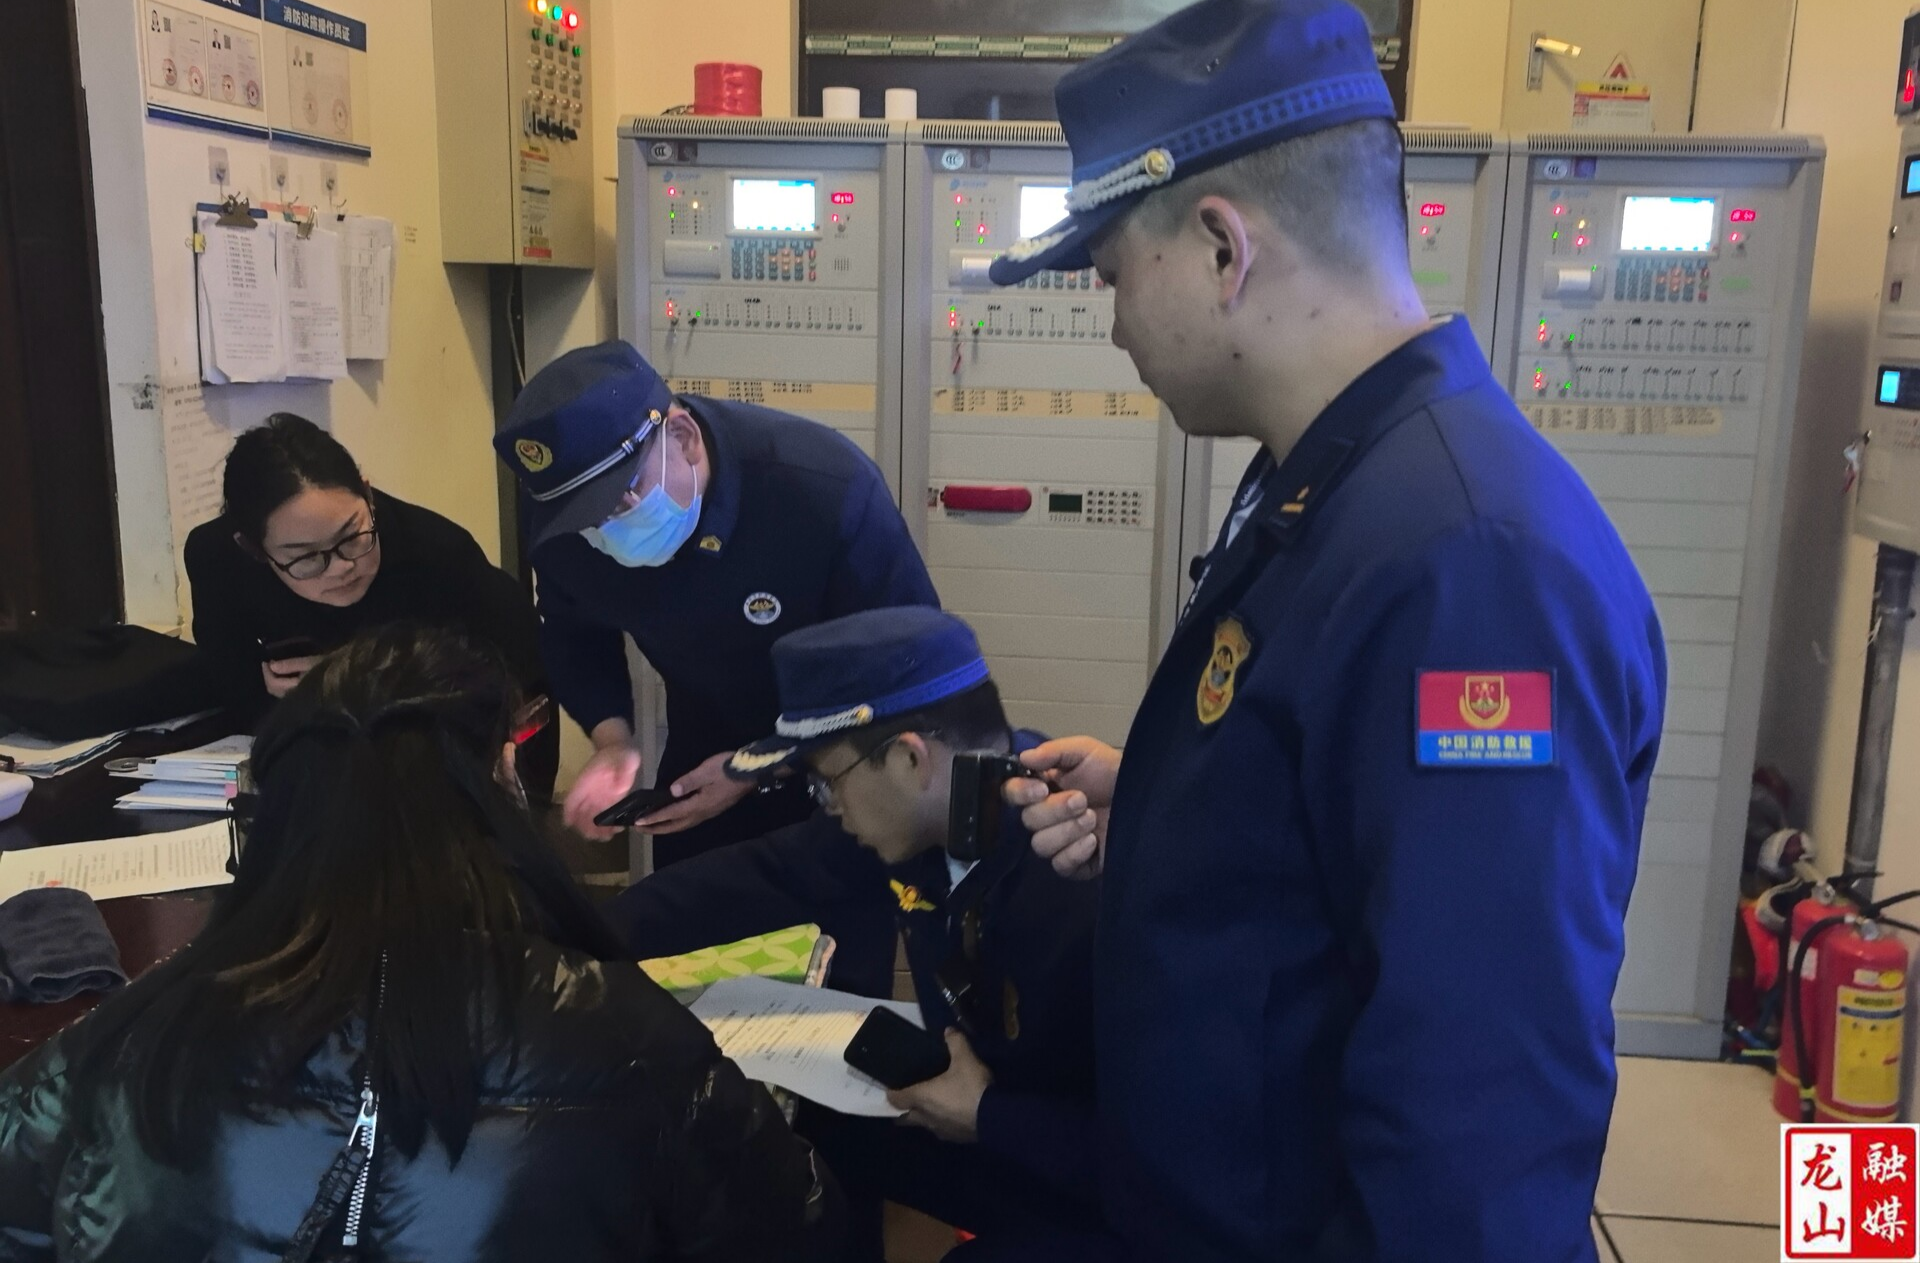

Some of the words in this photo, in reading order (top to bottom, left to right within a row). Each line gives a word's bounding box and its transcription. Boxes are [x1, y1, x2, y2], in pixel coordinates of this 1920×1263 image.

[283, 5, 350, 42] 消防设施操作员证
[1438, 735, 1532, 749] 中国消防救援
